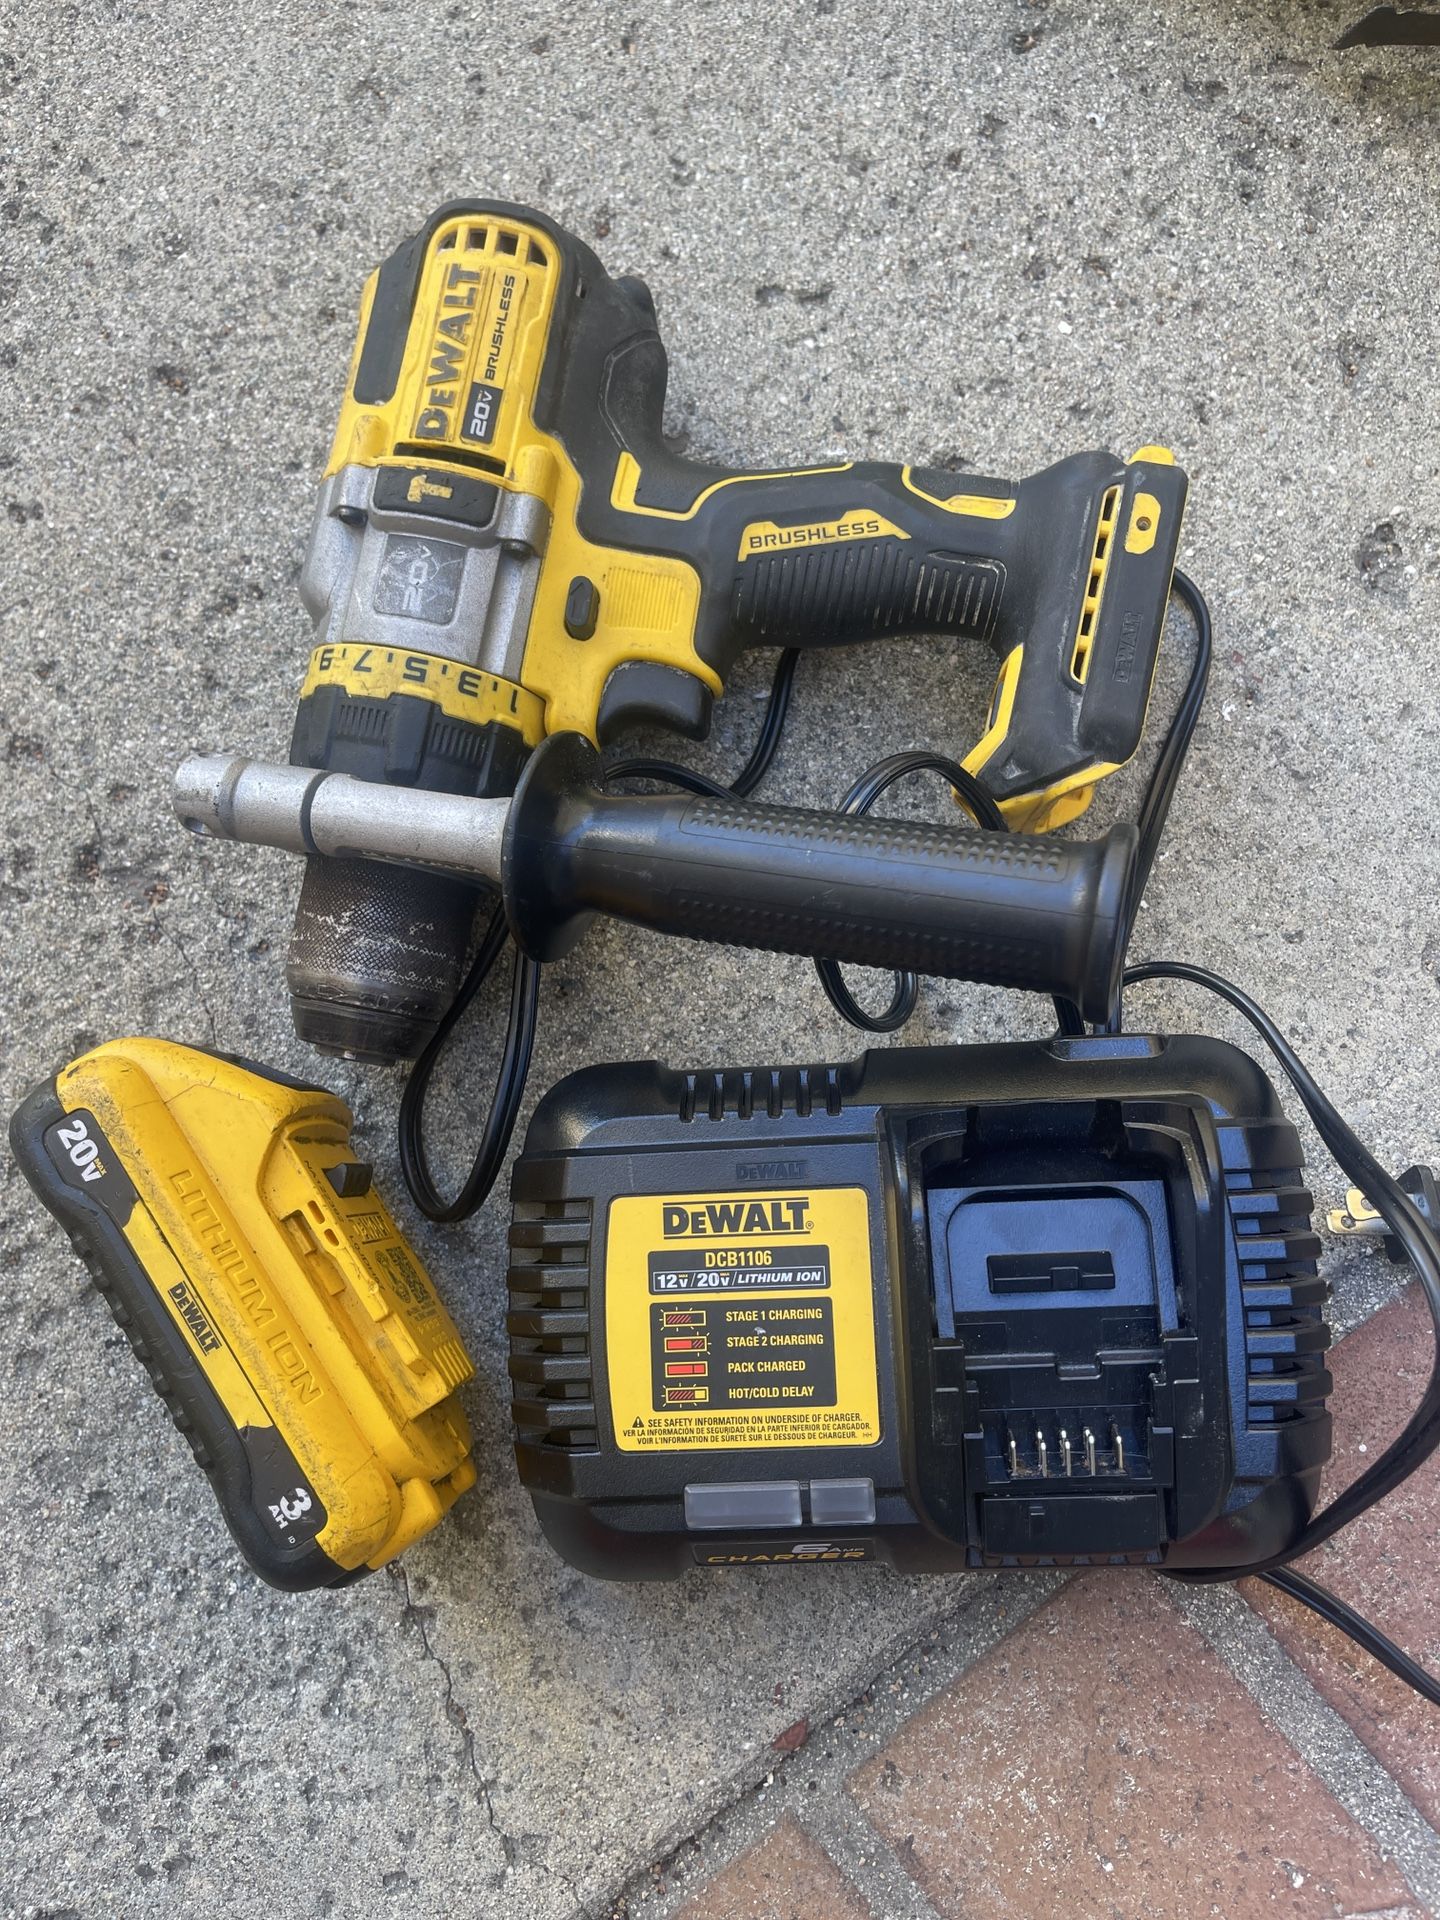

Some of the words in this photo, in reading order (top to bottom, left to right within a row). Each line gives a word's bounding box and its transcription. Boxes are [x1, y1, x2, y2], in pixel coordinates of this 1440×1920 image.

[485, 275, 515, 381] BRUSHLESS
[470, 390, 493, 438] 20V
[749, 520, 880, 548] BRUSHLESS
[353, 649, 373, 673] 7
[402, 655, 429, 683] 5
[457, 670, 482, 698] 3
[56, 1119, 102, 1183] 20V
[705, 1250, 773, 1268] DCB1106
[797, 1271, 822, 1281] ION
[169, 1168, 278, 1328] LITHIUM
[266, 1330, 325, 1407] ION
[726, 1310, 758, 1322] STAGE
[761, 1310, 766, 1321] 1
[768, 1308, 823, 1320] CHARGING
[726, 1336, 759, 1347] STAGE
[761, 1336, 768, 1347] 2
[770, 1334, 824, 1346] CHARGING
[728, 1362, 754, 1373] PACK
[757, 1360, 806, 1372] CHARGED
[729, 1387, 779, 1399] HOT/COLD
[783, 1386, 814, 1397] DELAY
[623, 1429, 636, 1437] VER
[706, 1426, 745, 1434] SEGURIDAD
[747, 1425, 756, 1433] EN
[767, 1424, 788, 1432] PARTE
[790, 1423, 820, 1431] INFERIOR
[822, 1423, 830, 1431] DE
[648, 1418, 662, 1428] SEE
[664, 1417, 693, 1427] SAFETY
[695, 1416, 749, 1426] INFORMATION
[752, 1416, 763, 1424] ON
[765, 1414, 810, 1424] UNDERSIDE
[812, 1414, 821, 1422] OF
[823, 1413, 863, 1422] CHARGER.
[637, 1437, 653, 1445] VOIR
[655, 1435, 708, 1444] L'INFORMATION
[748, 1433, 762, 1441] SUR
[773, 1432, 806, 1440] DESSOUS
[280, 1487, 312, 1520] 3
[267, 1505, 289, 1530] AH
[707, 1552, 865, 1563] CHARGER
